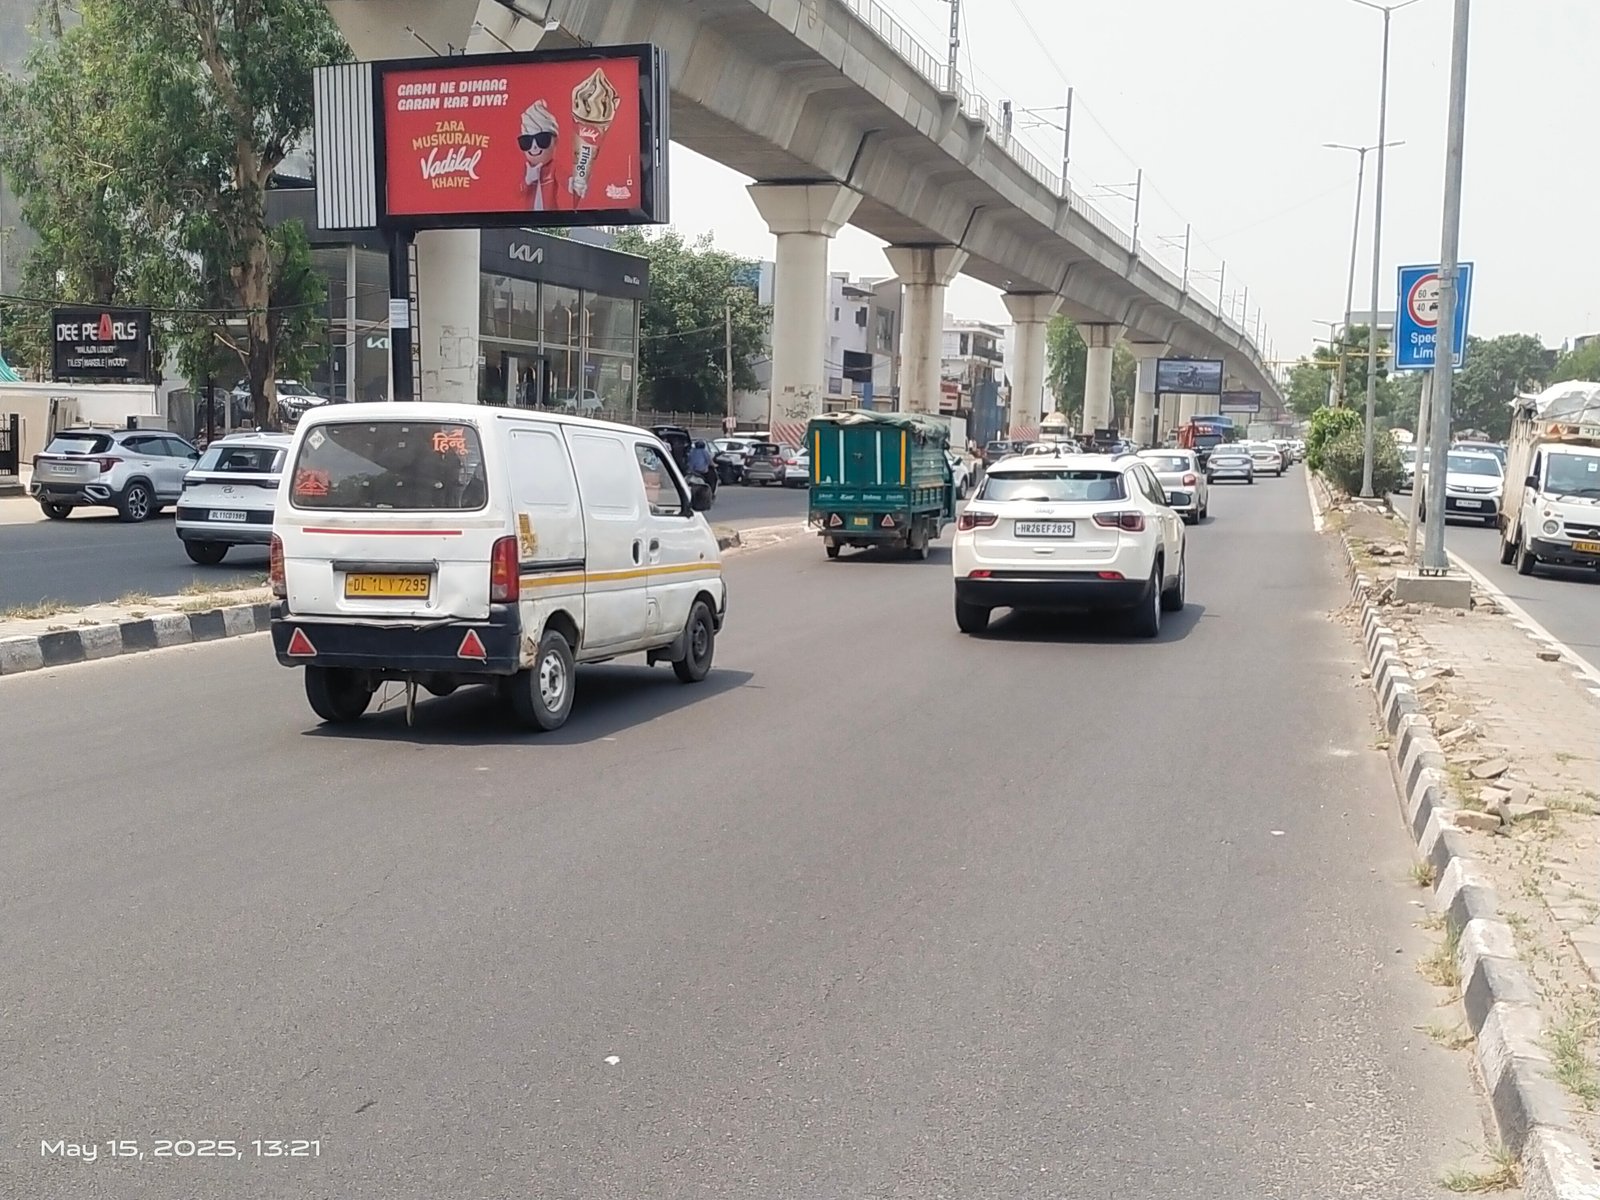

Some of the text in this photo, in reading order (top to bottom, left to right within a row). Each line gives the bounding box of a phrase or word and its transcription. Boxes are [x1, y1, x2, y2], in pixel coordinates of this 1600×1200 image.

[397, 78, 508, 97] GARMI NE DIMAAG
[397, 93, 509, 111] GARAM KAR DIYA?
[435, 120, 465, 133] ZARA
[412, 132, 490, 151] MUSKURAIYE
[420, 145, 482, 180] Vadilal
[576, 145, 591, 178] Flingo
[431, 176, 471, 190] KHAIYE
[1418, 290, 1427, 298] 60
[1417, 303, 1425, 312] 40
[57, 313, 137, 341] DEE PEARLS
[366, 336, 390, 349] KI
[1410, 331, 1437, 346] Spee
